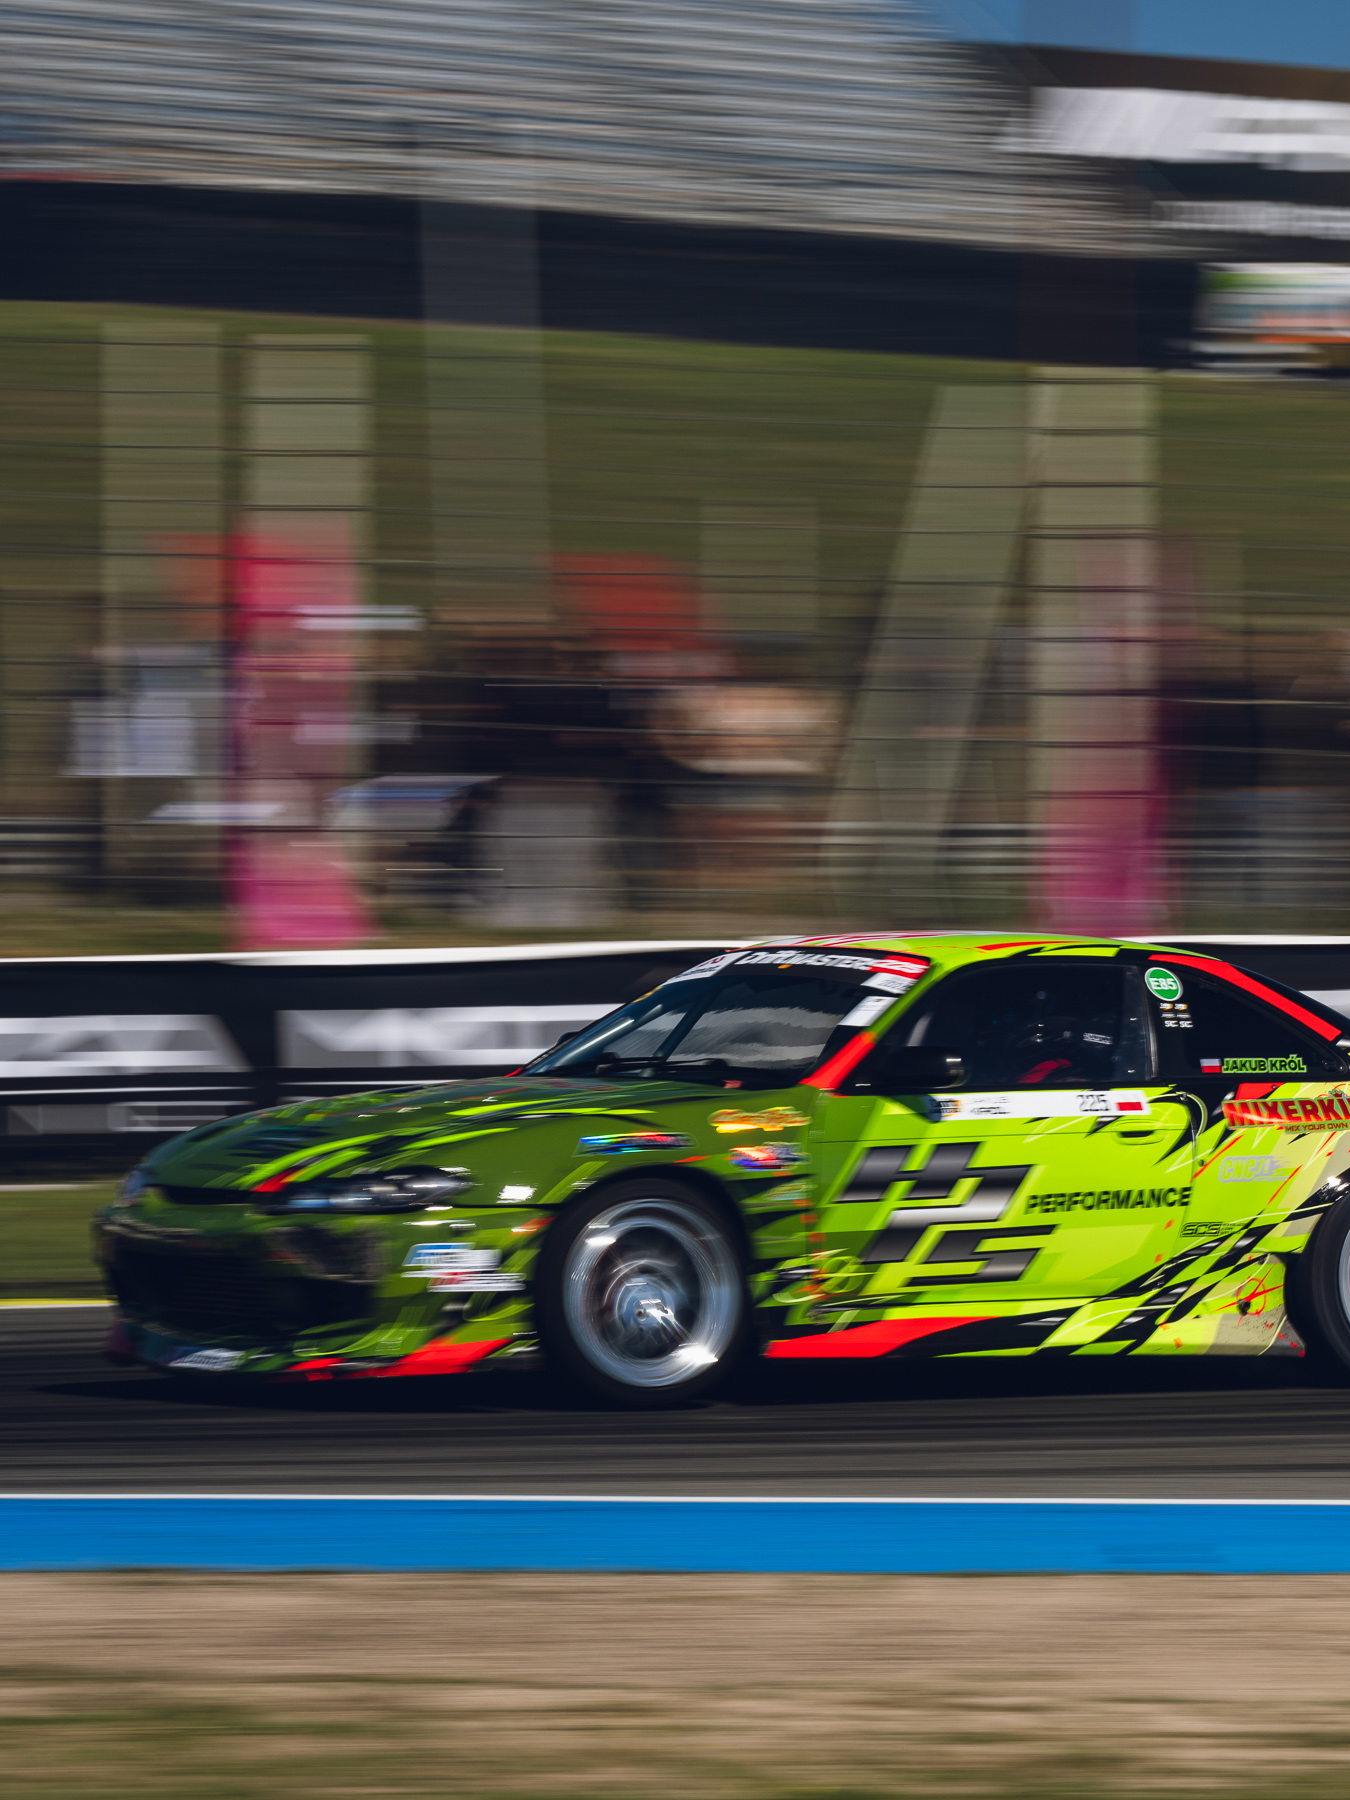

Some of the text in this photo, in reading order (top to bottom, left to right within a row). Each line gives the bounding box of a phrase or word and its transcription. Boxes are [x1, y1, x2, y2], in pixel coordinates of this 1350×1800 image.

[1149, 978, 1178, 990] E85
[1222, 1054, 1307, 1073] JAKUB KRÓL
[1285, 1124, 1300, 1132] MIX
[1302, 1123, 1326, 1131] YOUR
[1327, 1121, 1348, 1130] OWN
[1024, 1186, 1191, 1215] PERFORMANCE
